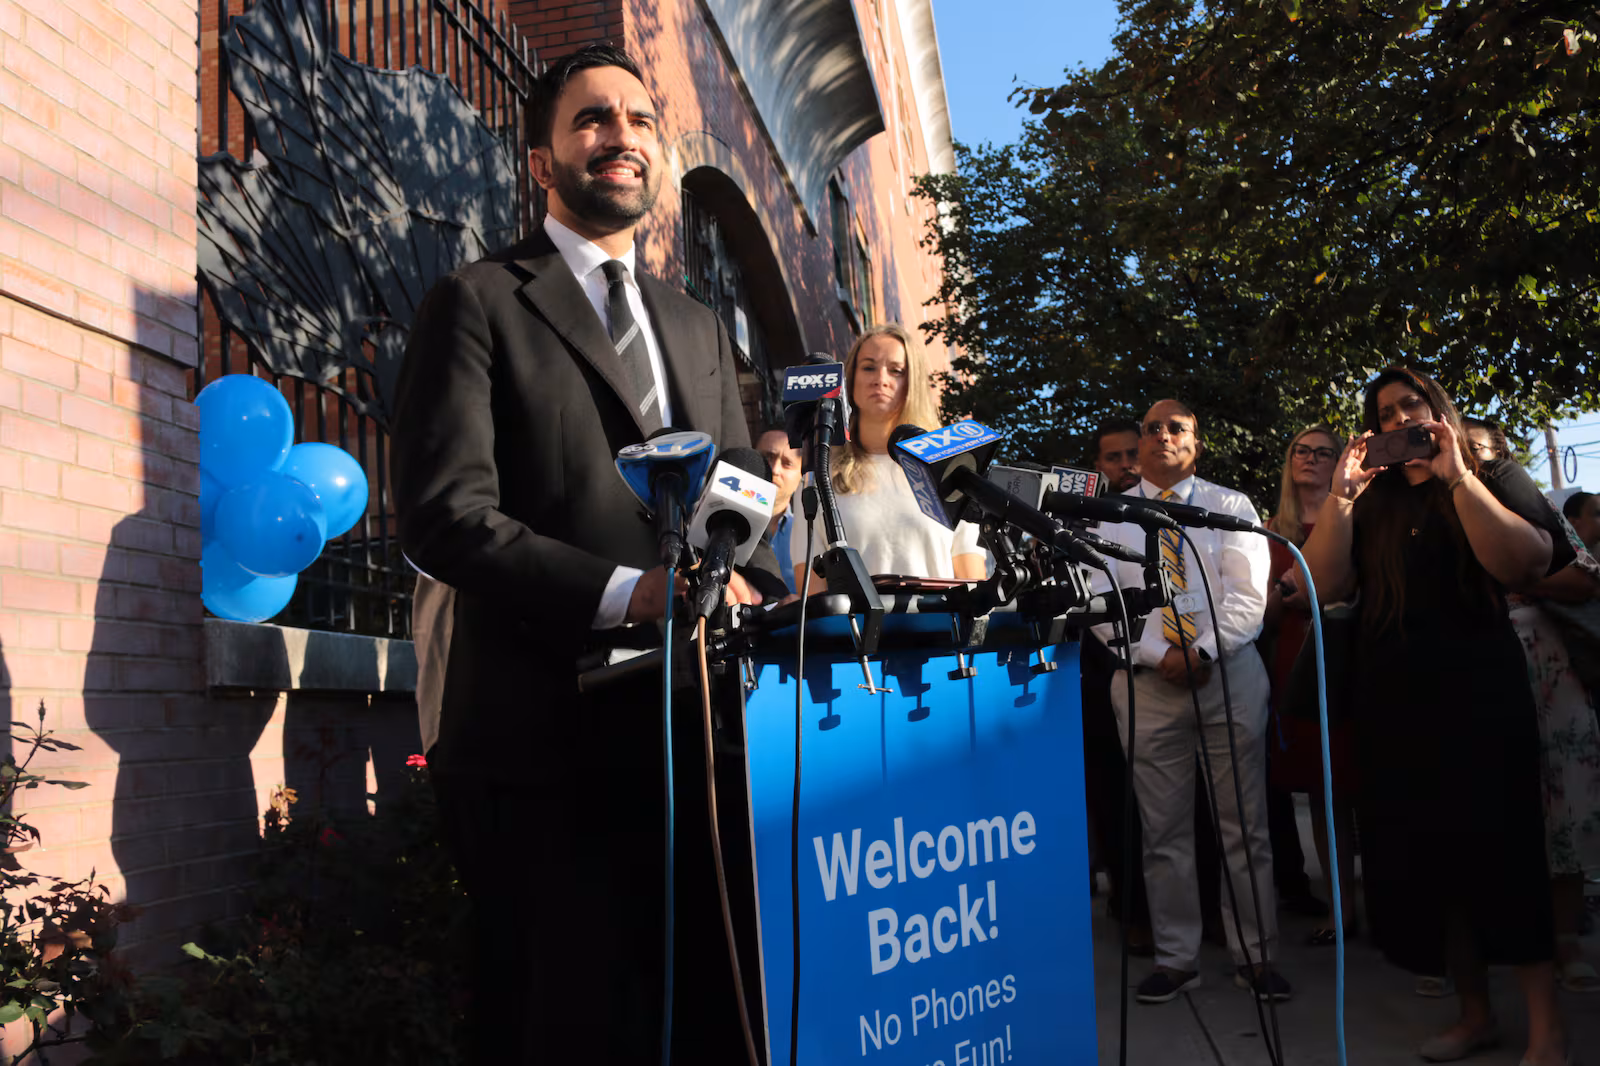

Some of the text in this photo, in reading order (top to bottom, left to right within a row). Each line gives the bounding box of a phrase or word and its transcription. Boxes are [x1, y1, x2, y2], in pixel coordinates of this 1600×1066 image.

[903, 429, 966, 455] PIX
[719, 476, 741, 492] 4
[1012, 475, 1022, 494] ORK
[1060, 472, 1075, 493] OX
[1072, 473, 1087, 496] WS
[813, 811, 1036, 902] Welcome
[868, 880, 998, 975] Back!
[859, 974, 1017, 1056] No Phones
[955, 1025, 1013, 1066] Fun!
